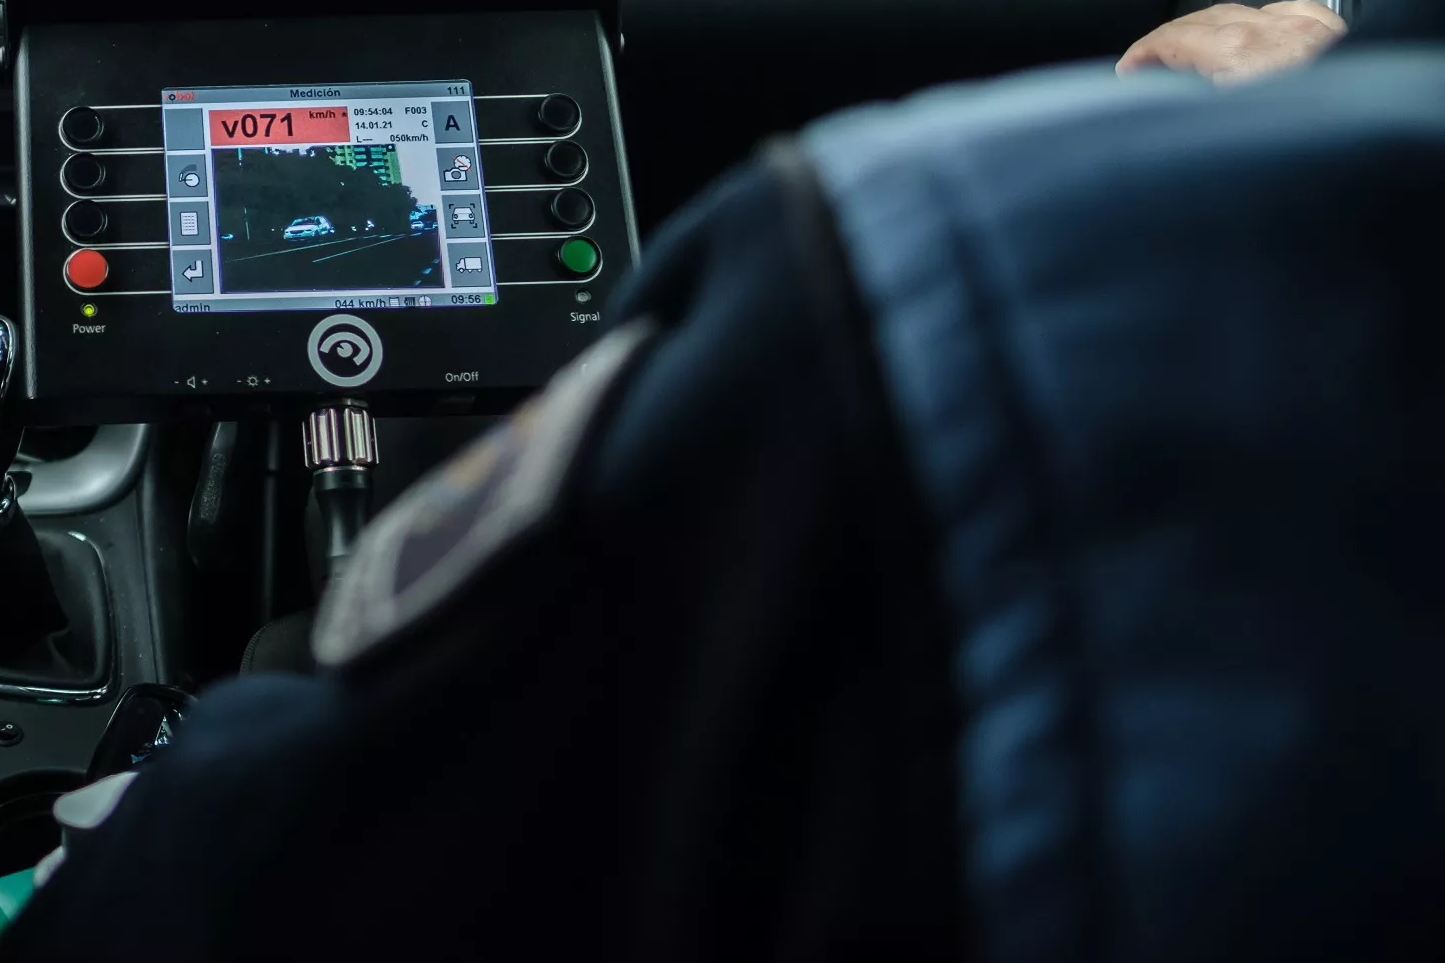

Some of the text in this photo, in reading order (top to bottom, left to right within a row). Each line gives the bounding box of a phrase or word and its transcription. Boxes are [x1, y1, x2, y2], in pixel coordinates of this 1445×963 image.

[290, 88, 341, 98] Medición
[447, 86, 465, 95] 111
[353, 106, 427, 116] 09:54:04 F003
[221, 110, 336, 138] v071 km/h
[355, 120, 428, 130] 14.01.21 C
[444, 114, 461, 131] A
[175, 294, 481, 312] admin 044 km/h 09:56
[570, 312, 600, 324] Signal
[72, 323, 106, 334] Power
[445, 371, 479, 383] On/Off
